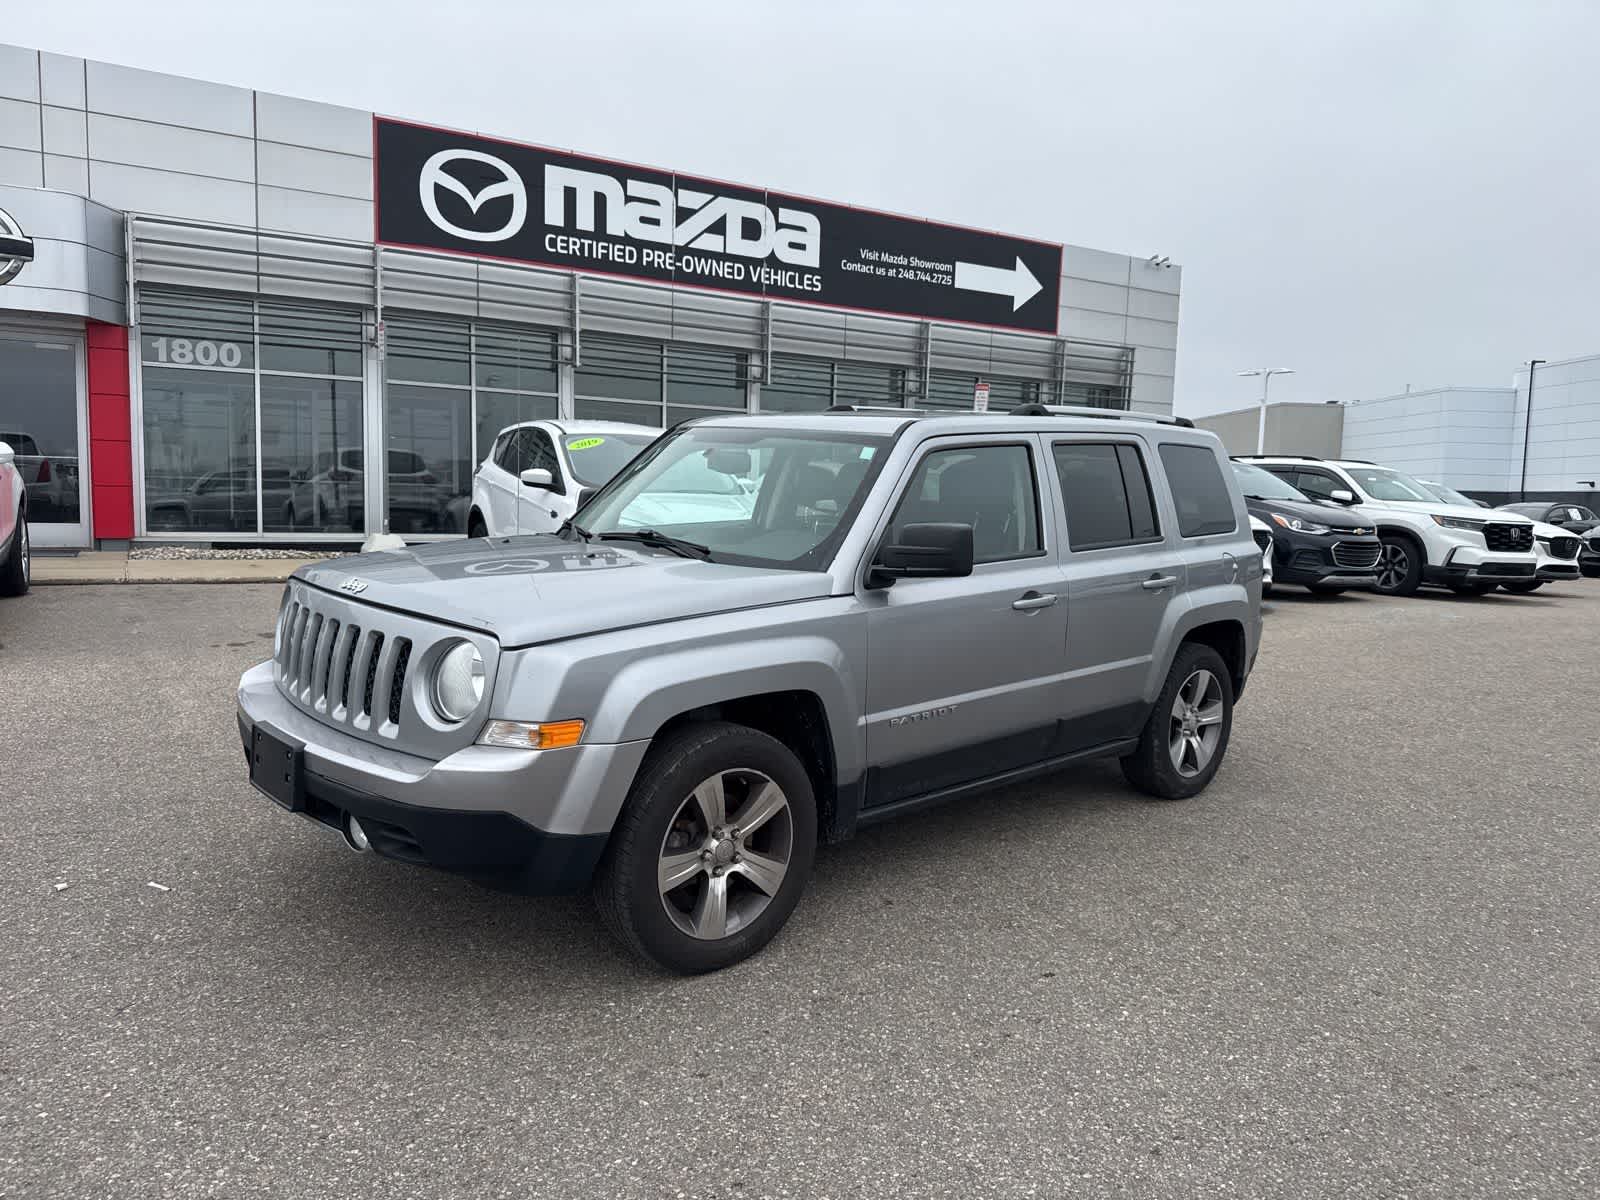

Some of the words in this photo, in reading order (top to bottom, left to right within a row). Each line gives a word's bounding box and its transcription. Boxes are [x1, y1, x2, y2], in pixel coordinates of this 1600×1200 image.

[544, 233, 637, 264] CERTIFIED
[642, 249, 745, 281] PRE-OWNED
[749, 266, 822, 292] VEHICLES
[841, 259, 874, 274] Contact
[875, 267, 886, 276] us
[887, 267, 897, 277] at
[898, 268, 952, 286] 248.744.2725
[860, 248, 879, 261] Visit
[881, 251, 908, 266] Mazda
[909, 257, 953, 273] Showroom
[152, 337, 242, 367] 1800
[888, 705, 957, 728] PATRIOT
